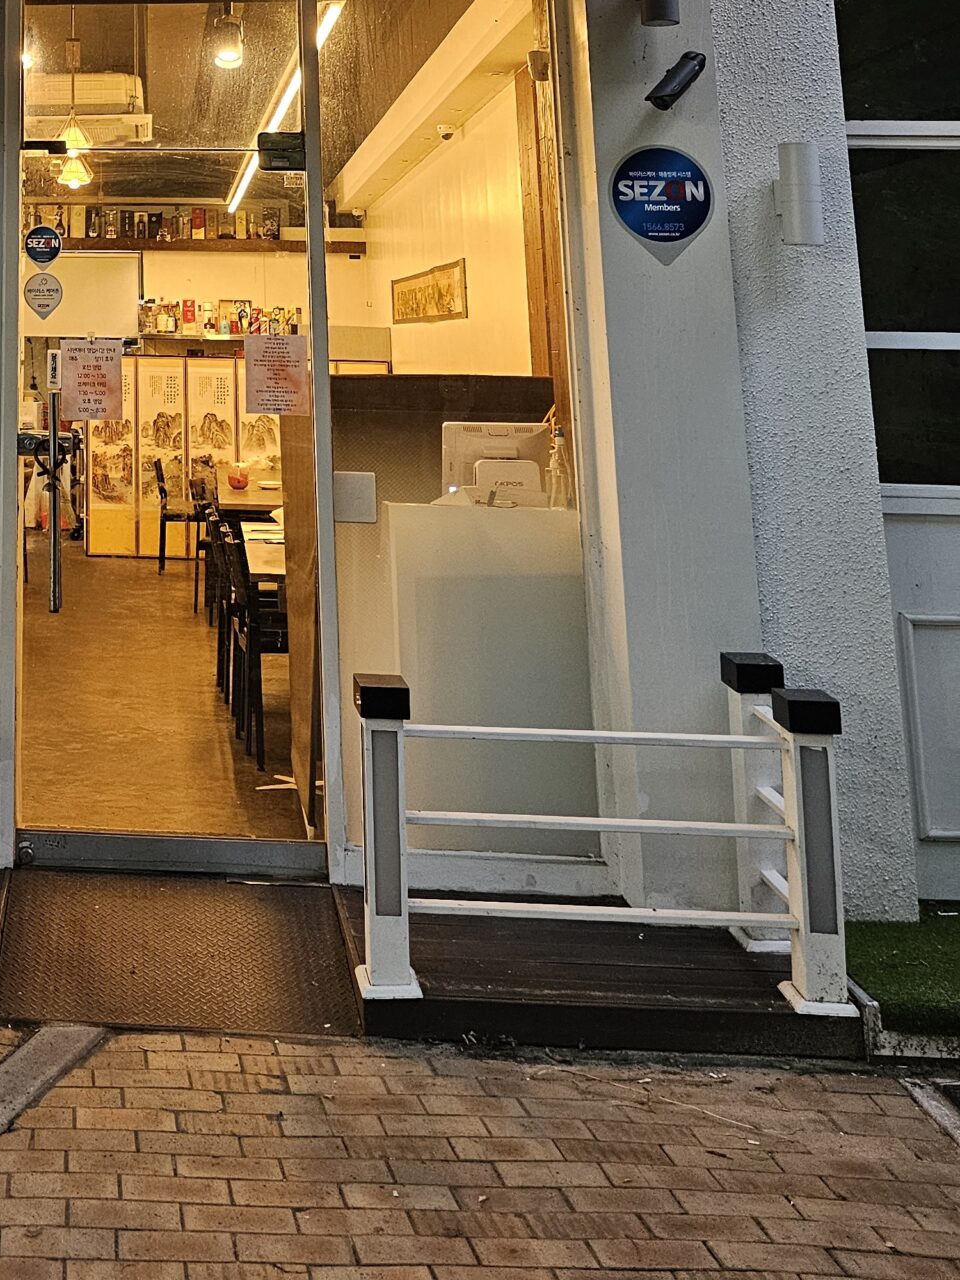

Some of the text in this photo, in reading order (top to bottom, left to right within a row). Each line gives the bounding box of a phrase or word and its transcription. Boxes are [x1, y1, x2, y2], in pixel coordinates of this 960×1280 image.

[617, 179, 705, 202] SEZON
[644, 203, 681, 212] Members
[27, 238, 59, 248] SEZON
